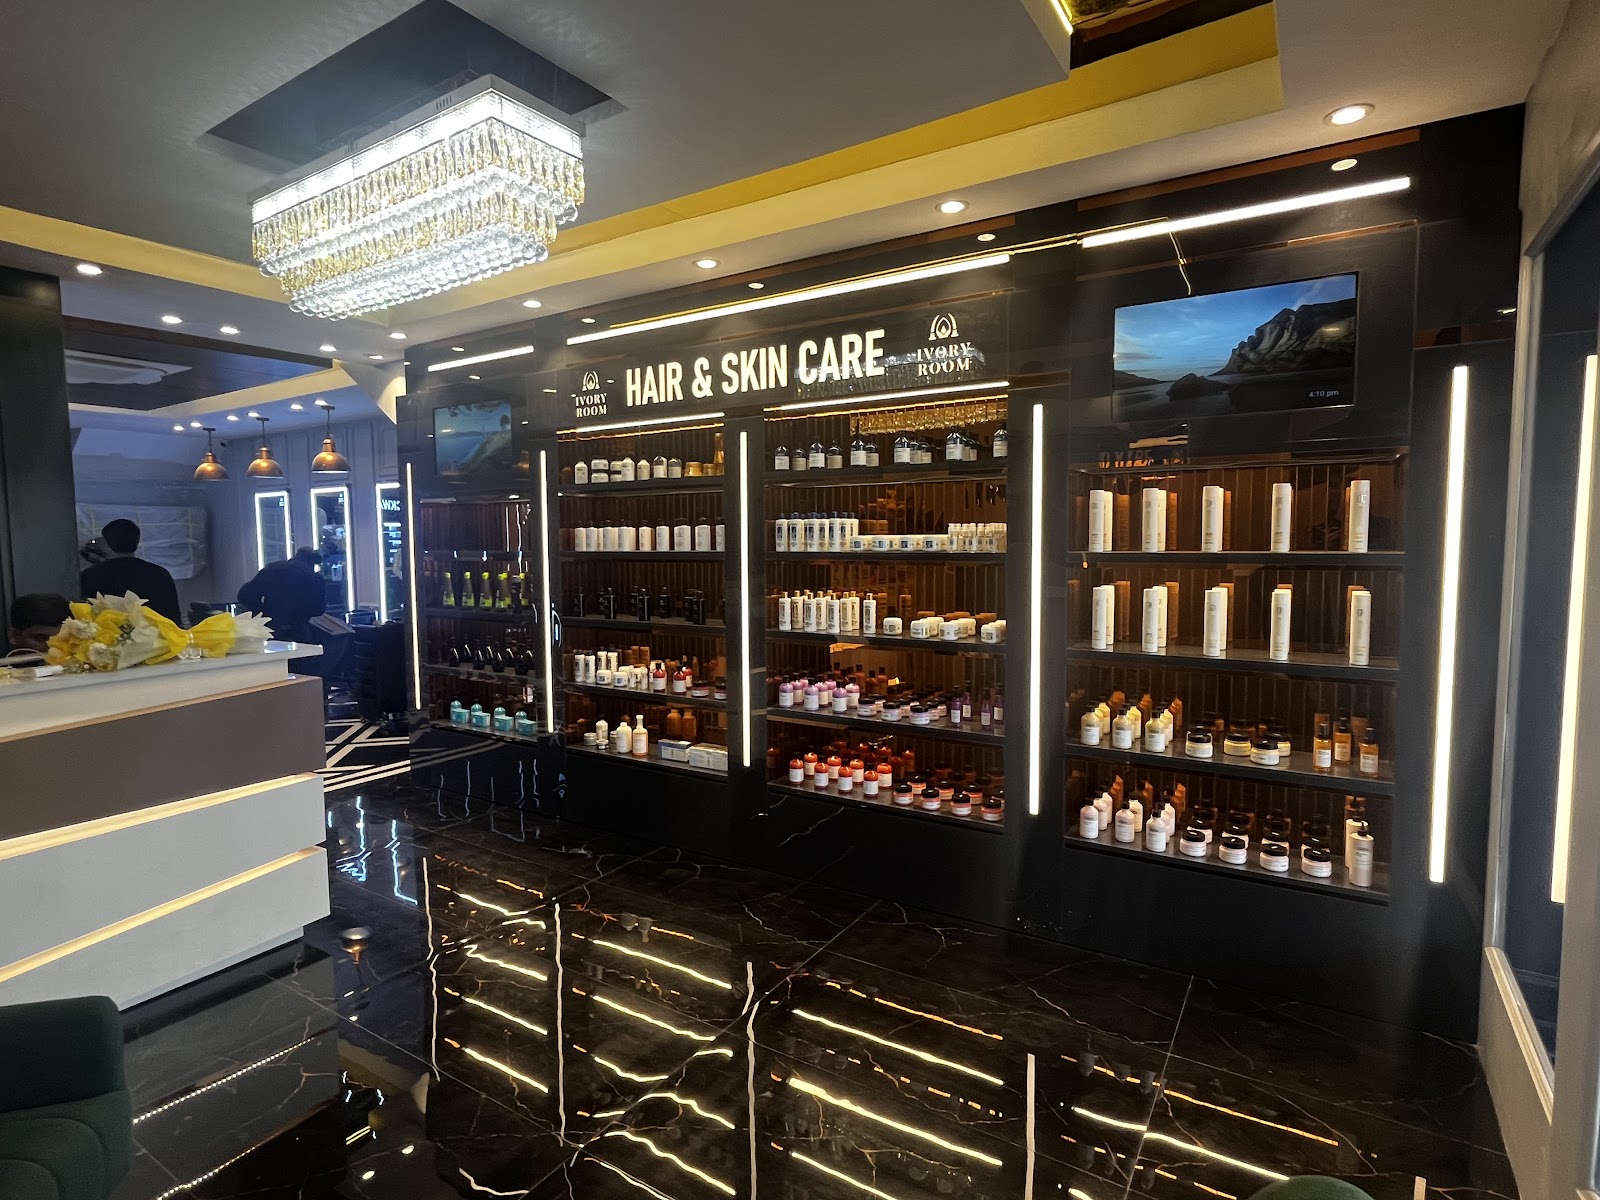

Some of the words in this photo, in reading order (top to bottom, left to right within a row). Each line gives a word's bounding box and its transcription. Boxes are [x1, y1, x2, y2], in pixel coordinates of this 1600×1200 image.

[917, 341, 972, 362] IVORY
[626, 361, 684, 407] HAIR
[691, 356, 714, 399] &
[721, 344, 788, 395] SKIN
[798, 328, 886, 386] CARE
[918, 357, 970, 377] ROOM
[575, 393, 608, 407] IVORY
[1308, 390, 1325, 398] 4:10
[1326, 390, 1339, 398] pm
[576, 404, 607, 418] ROOM
